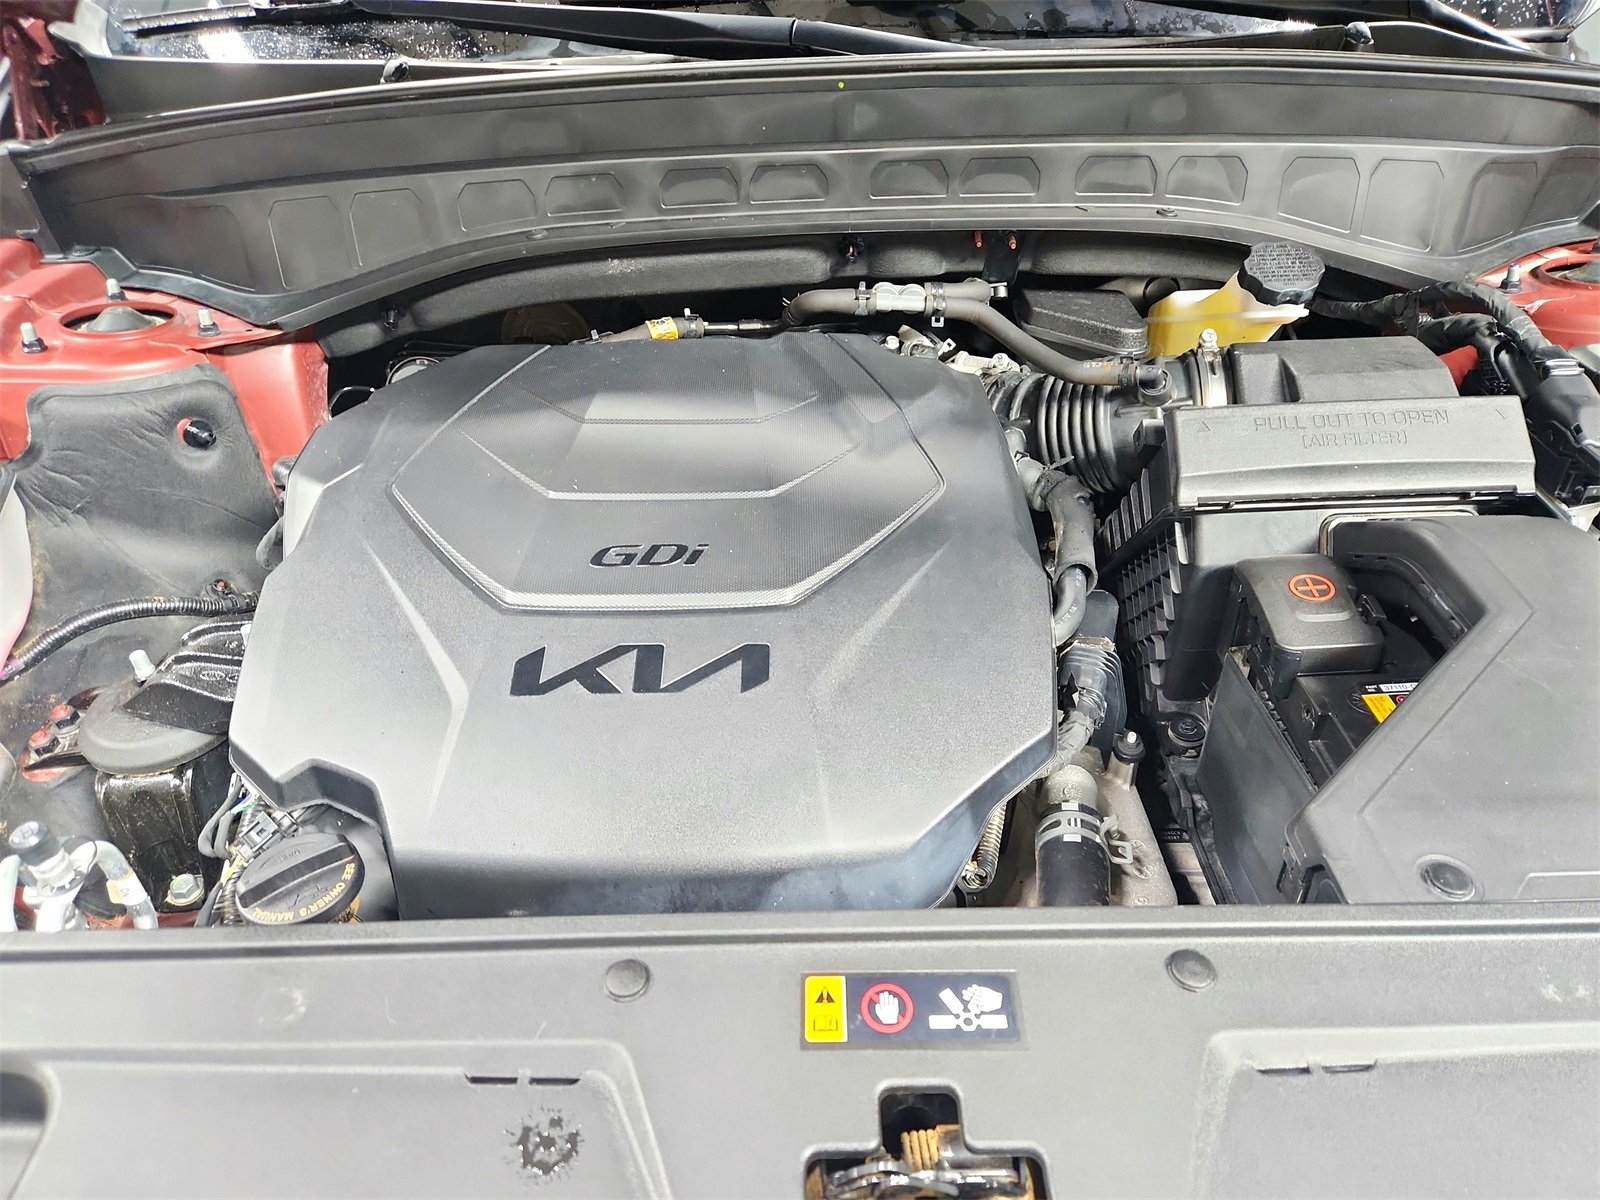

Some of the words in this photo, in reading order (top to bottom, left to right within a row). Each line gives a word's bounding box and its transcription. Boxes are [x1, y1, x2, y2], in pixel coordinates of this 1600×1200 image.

[1253, 415, 1307, 431] PULL
[1312, 413, 1353, 429] OUT
[1360, 411, 1387, 427] TO
[1393, 409, 1450, 425] OPEN
[589, 543, 709, 567] GDi
[509, 643, 770, 696] KIA
[341, 862, 356, 881] SEE
[299, 882, 346, 917] OWNER'S
[252, 907, 294, 921] MANUAL
